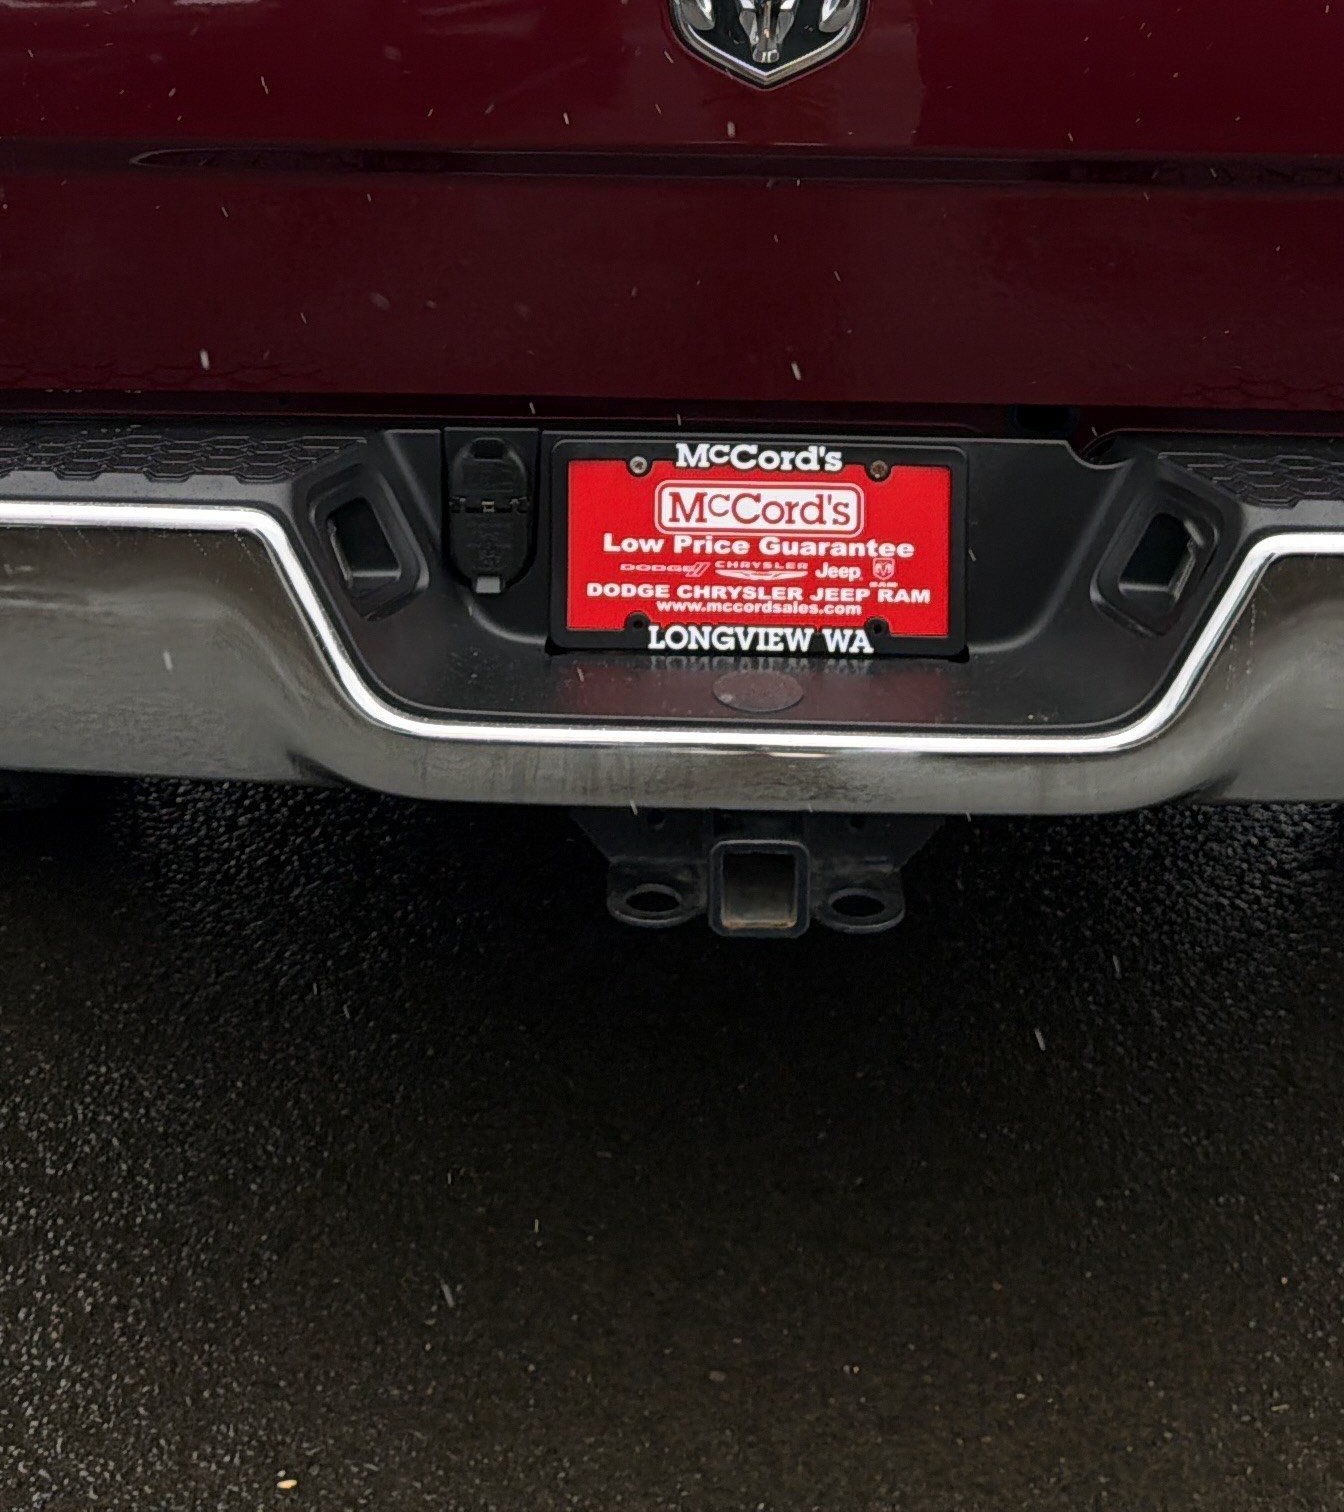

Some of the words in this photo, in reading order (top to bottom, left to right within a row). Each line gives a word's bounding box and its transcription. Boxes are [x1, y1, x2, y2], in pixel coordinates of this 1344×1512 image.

[675, 442, 843, 472] McCord's
[668, 491, 851, 526] McCord's
[602, 533, 664, 554] Low
[673, 535, 751, 556] Price
[758, 537, 915, 559] Guarantee
[714, 560, 809, 570] CHRYSLER
[814, 561, 862, 582] Jeep
[586, 582, 671, 599] DODGE
[676, 584, 803, 601] CHRYSLER
[809, 587, 871, 603] JEEP
[876, 589, 931, 605] RAM
[655, 598, 863, 617] www.mccordsales.com
[647, 625, 816, 653] LONGVIEW
[820, 629, 875, 654] WA
